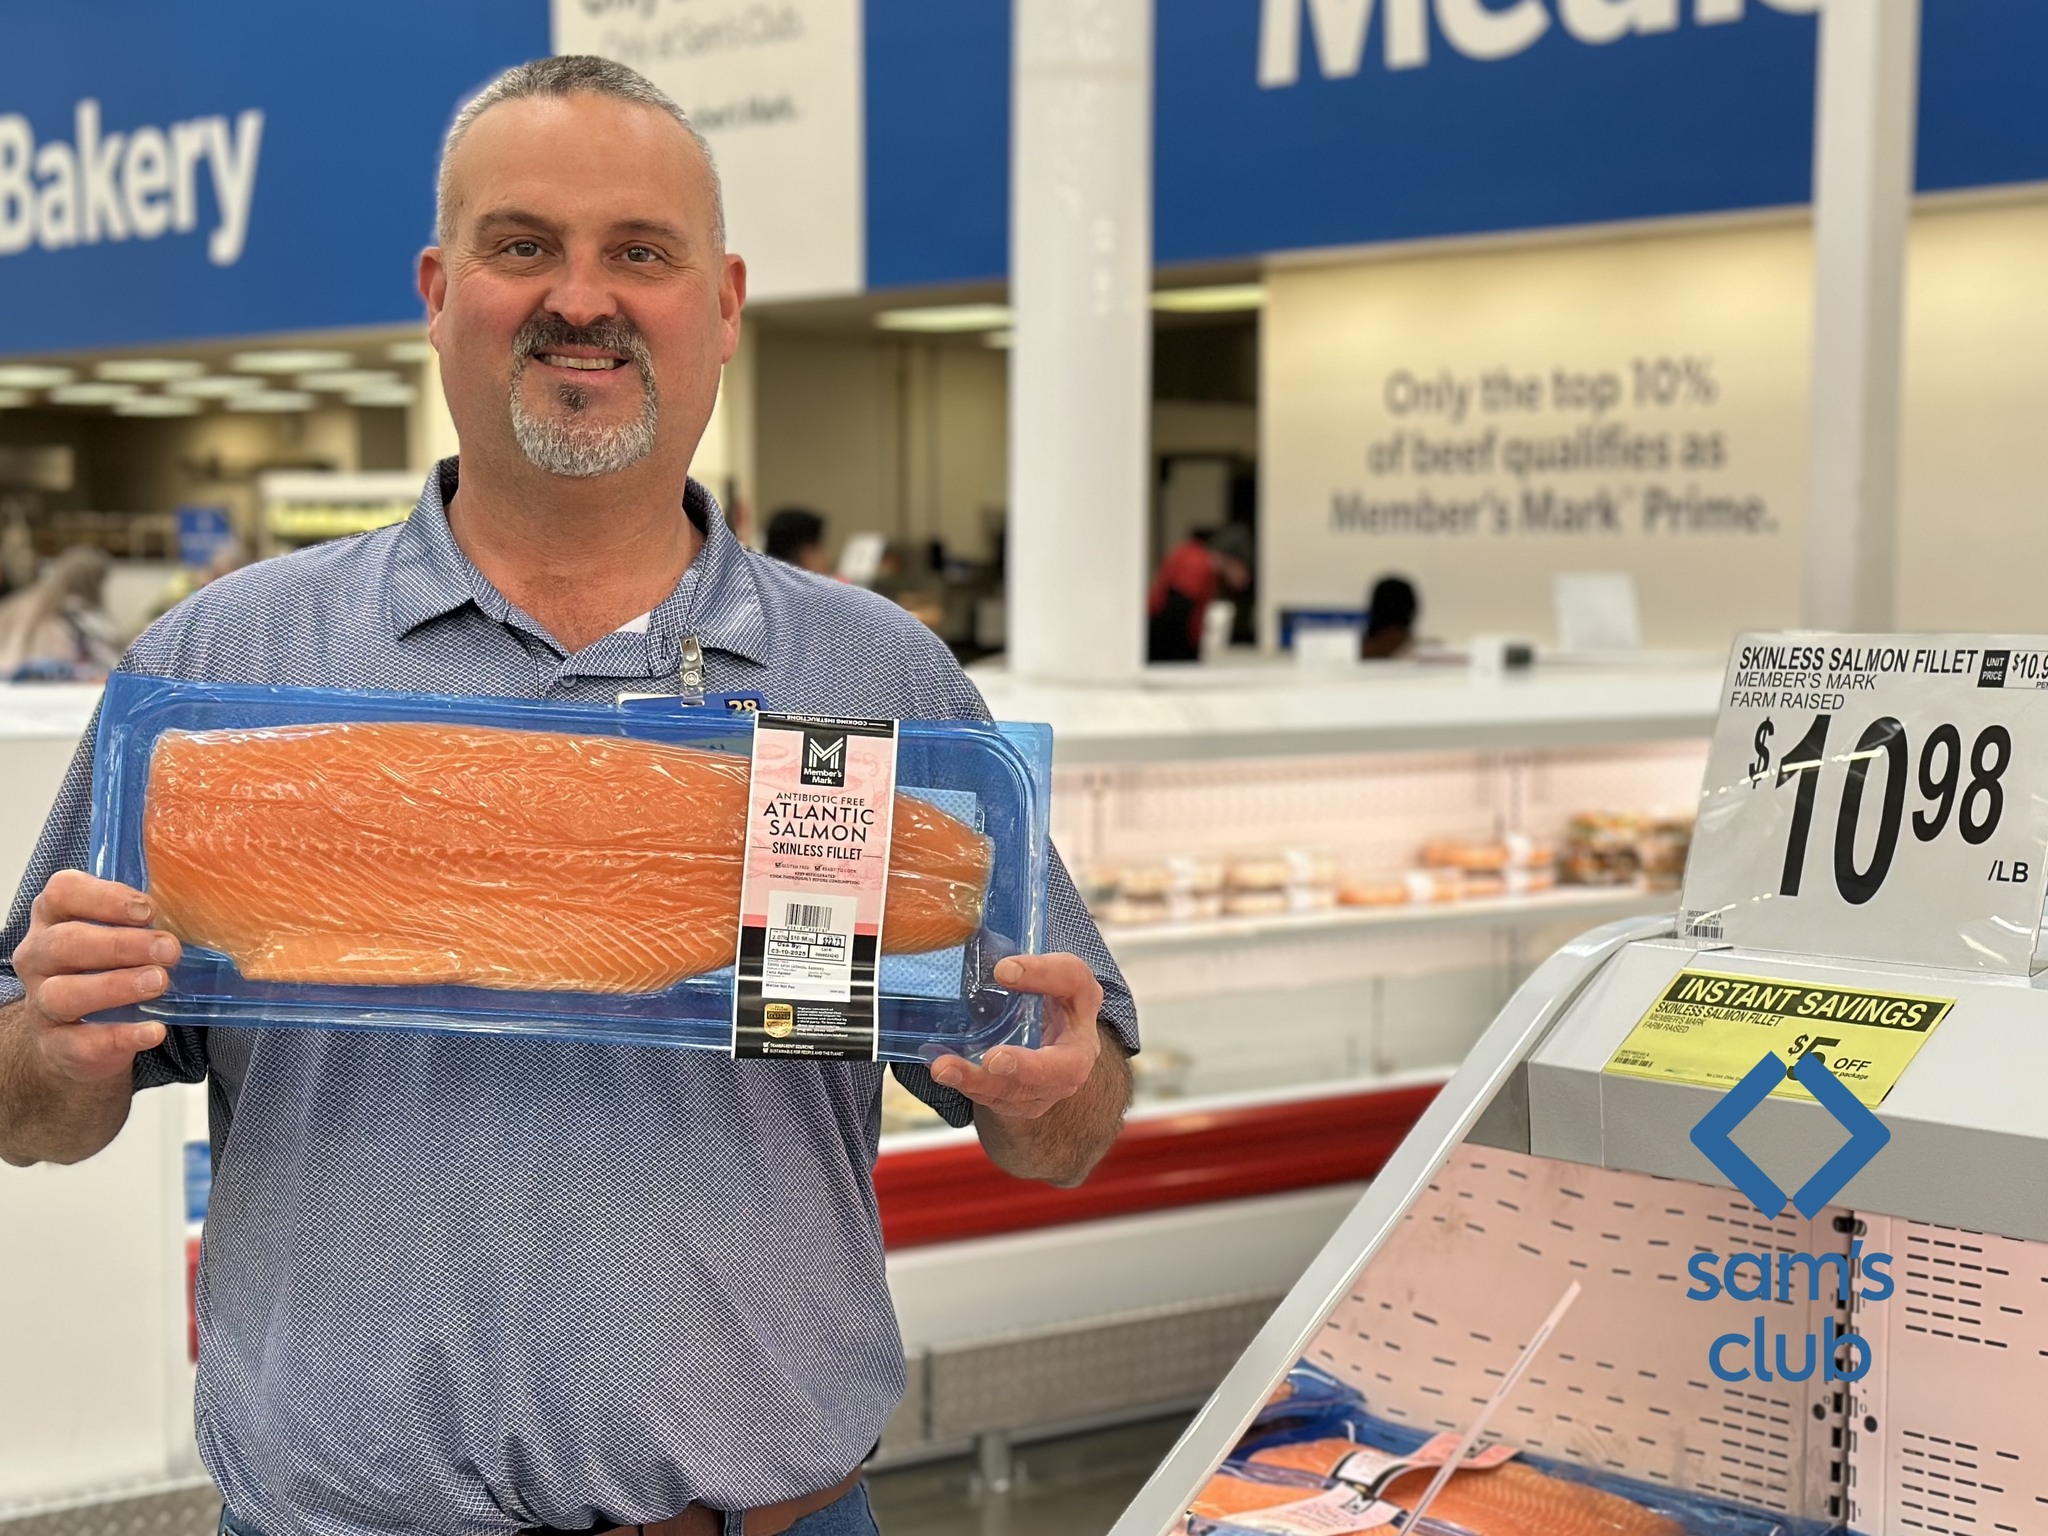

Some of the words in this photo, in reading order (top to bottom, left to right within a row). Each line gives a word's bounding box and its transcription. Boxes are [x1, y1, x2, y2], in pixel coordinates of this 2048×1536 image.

[0, 97, 264, 267] Bakery
[1384, 368, 1471, 425] Only
[1480, 367, 1543, 412] the
[1550, 366, 1622, 420] top
[1631, 357, 1720, 406] 10%
[1365, 428, 1407, 475] of
[1410, 427, 1497, 475] beef
[1502, 421, 1670, 482] qualifies
[1679, 430, 1726, 471] as
[1739, 646, 1824, 671] SKINLESS
[1829, 647, 1908, 673] SALMON
[1912, 649, 1979, 673] FILLET
[1986, 657, 2005, 667] UNIT
[1734, 671, 1822, 688] MEMBER'S
[1826, 673, 1877, 690] MARK
[1981, 671, 2003, 680] PRICE
[1730, 691, 1776, 707] FARM
[1780, 692, 1845, 710] RAISED
[786, 714, 835, 724] INSTRUCTIONS
[835, 719, 868, 727] COOKING
[803, 767, 842, 778] Member's
[776, 792, 838, 805] ANTIBIOTIC
[841, 796, 865, 807] FREE
[763, 801, 874, 825] ATLANTIC
[769, 819, 866, 843] SALMON
[772, 841, 823, 857] SKINLESS
[827, 846, 862, 861] FILLET
[1988, 859, 2029, 883] /LB
[1677, 977, 1801, 1013] INSTANT
[1797, 990, 1928, 1027] SAVINGS
[1649, 1013, 1685, 1024] MEMBER'S
[1683, 1018, 1706, 1026] MARK
[1655, 1002, 1705, 1017] SKINLESS
[1703, 1007, 1749, 1022] SALMON
[1745, 1013, 1784, 1027] FILLET
[1642, 1021, 1663, 1031] FARM
[1662, 1023, 1689, 1034] RAISED
[1833, 1057, 1872, 1072] OFF
